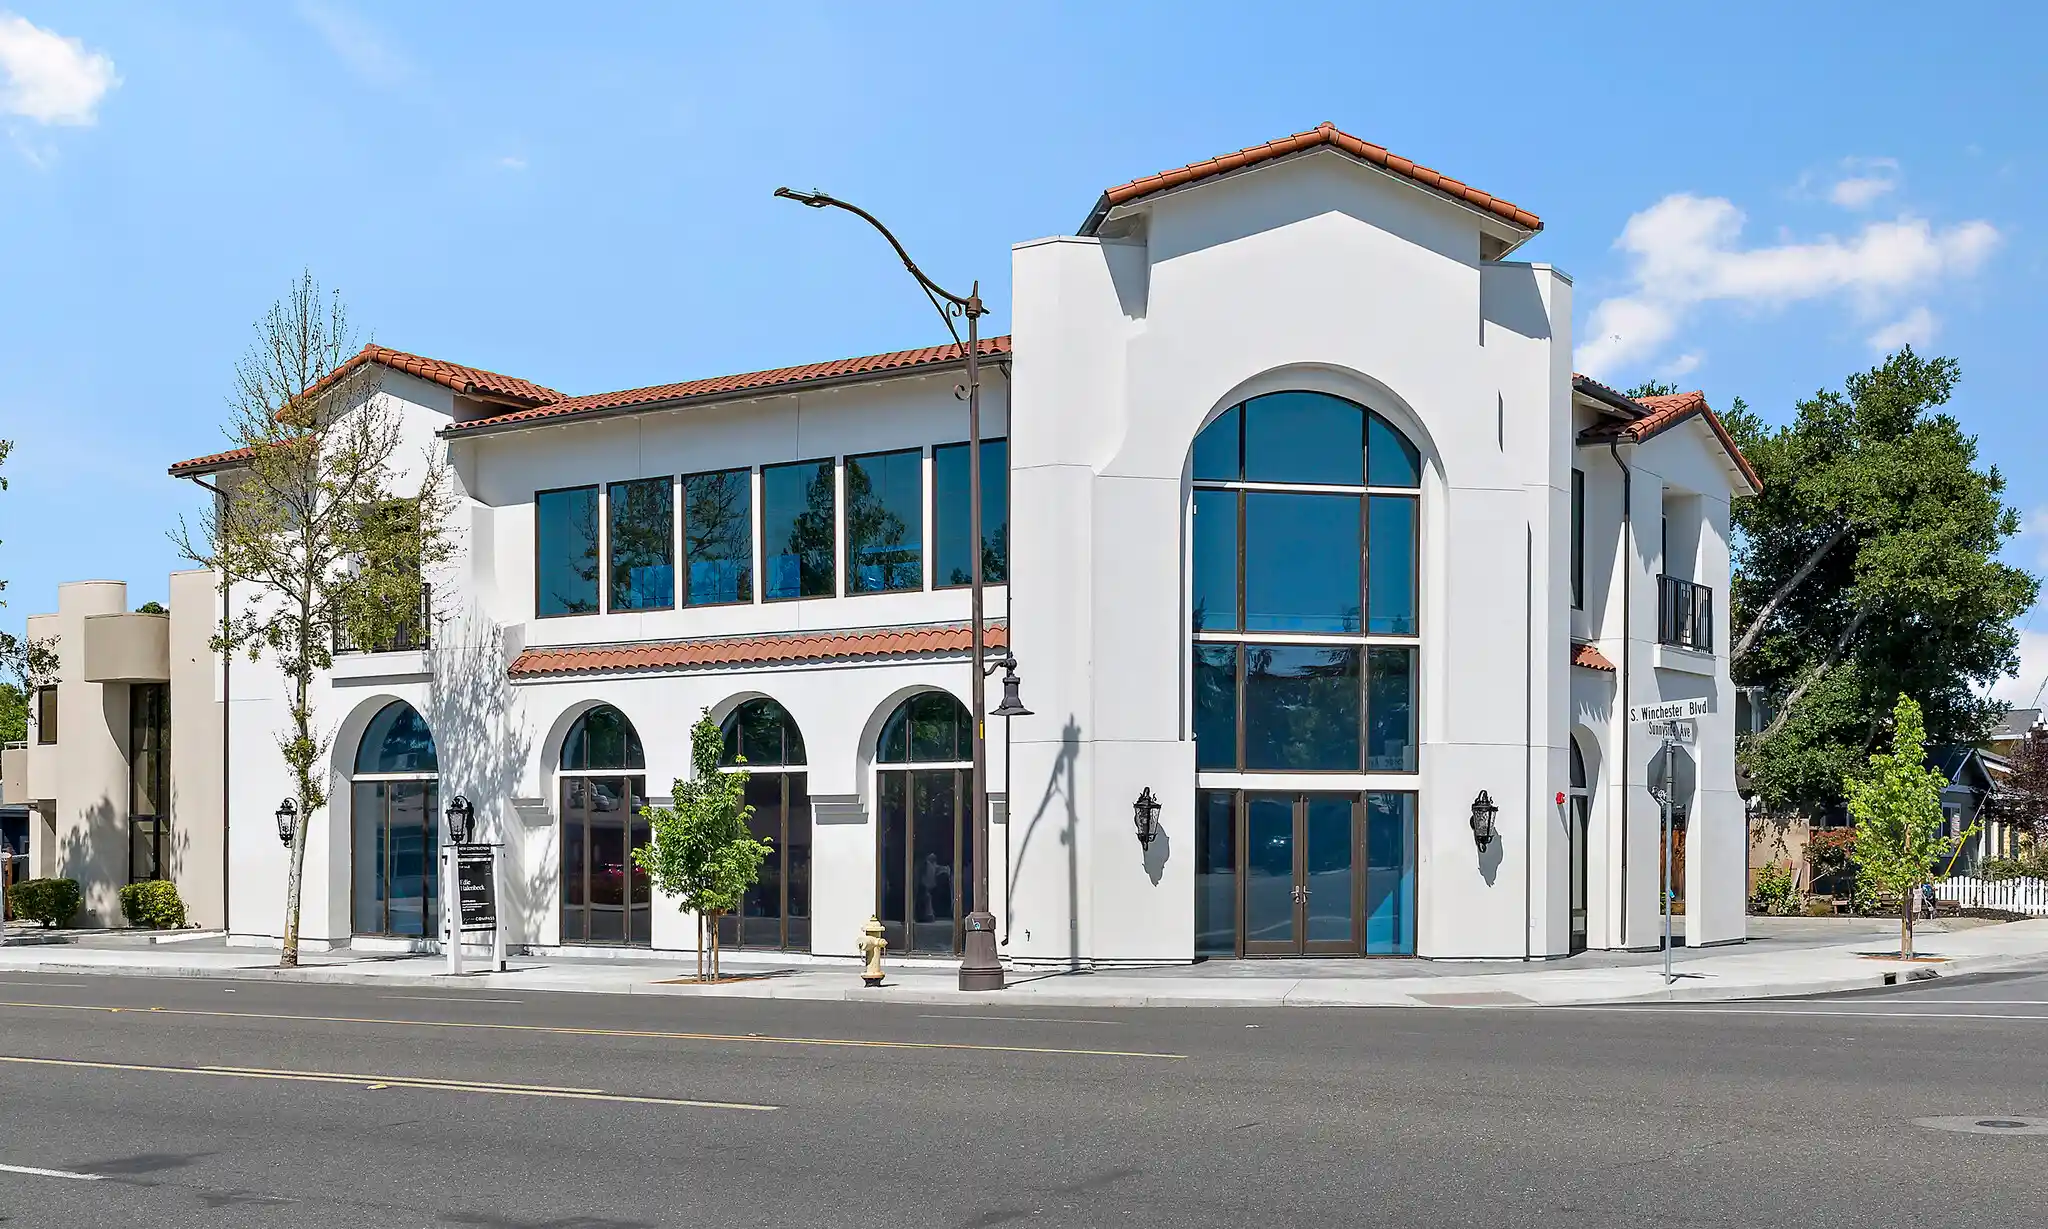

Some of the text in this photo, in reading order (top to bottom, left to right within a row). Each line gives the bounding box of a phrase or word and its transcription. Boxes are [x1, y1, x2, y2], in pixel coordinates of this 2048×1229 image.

[1630, 701, 1707, 721] S. Winchester Blvd
[1679, 723, 1691, 738] Ave
